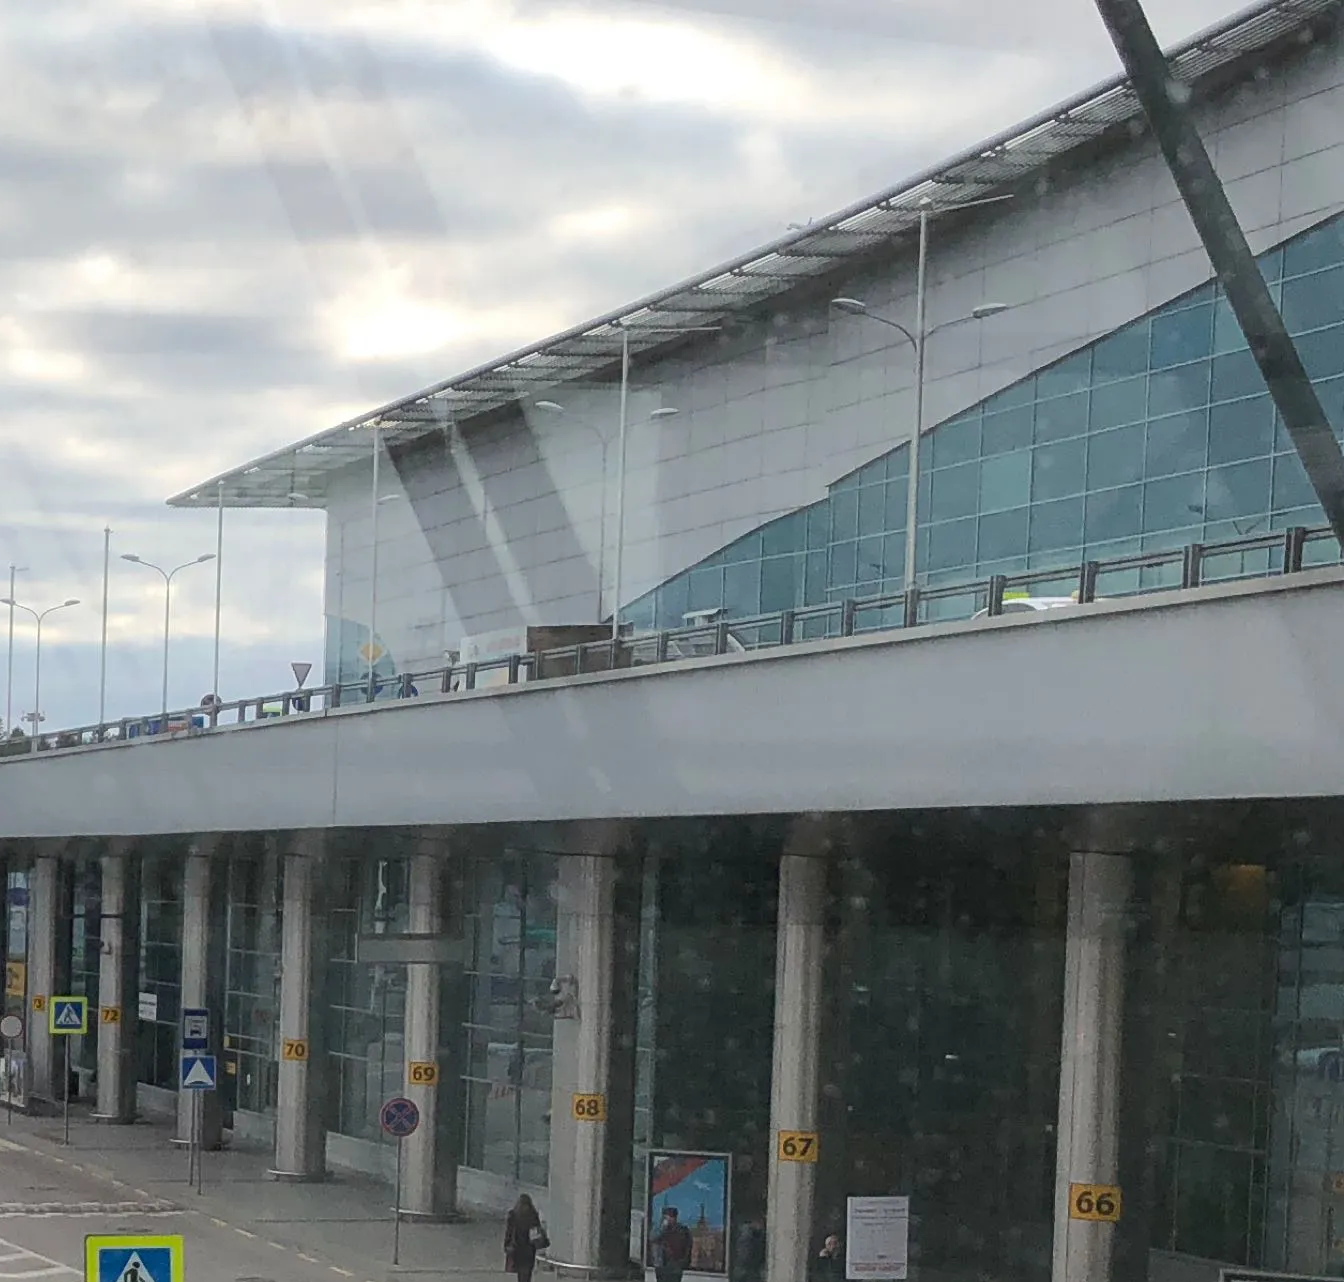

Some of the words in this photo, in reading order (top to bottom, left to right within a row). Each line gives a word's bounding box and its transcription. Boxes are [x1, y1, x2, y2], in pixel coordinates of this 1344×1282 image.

[102, 1009, 118, 1021] 72
[285, 1043, 305, 1057] 70
[412, 1065, 435, 1082] 69
[575, 1099, 600, 1116] 68
[782, 1136, 815, 1158] 67
[1075, 1191, 1117, 1217] 66
